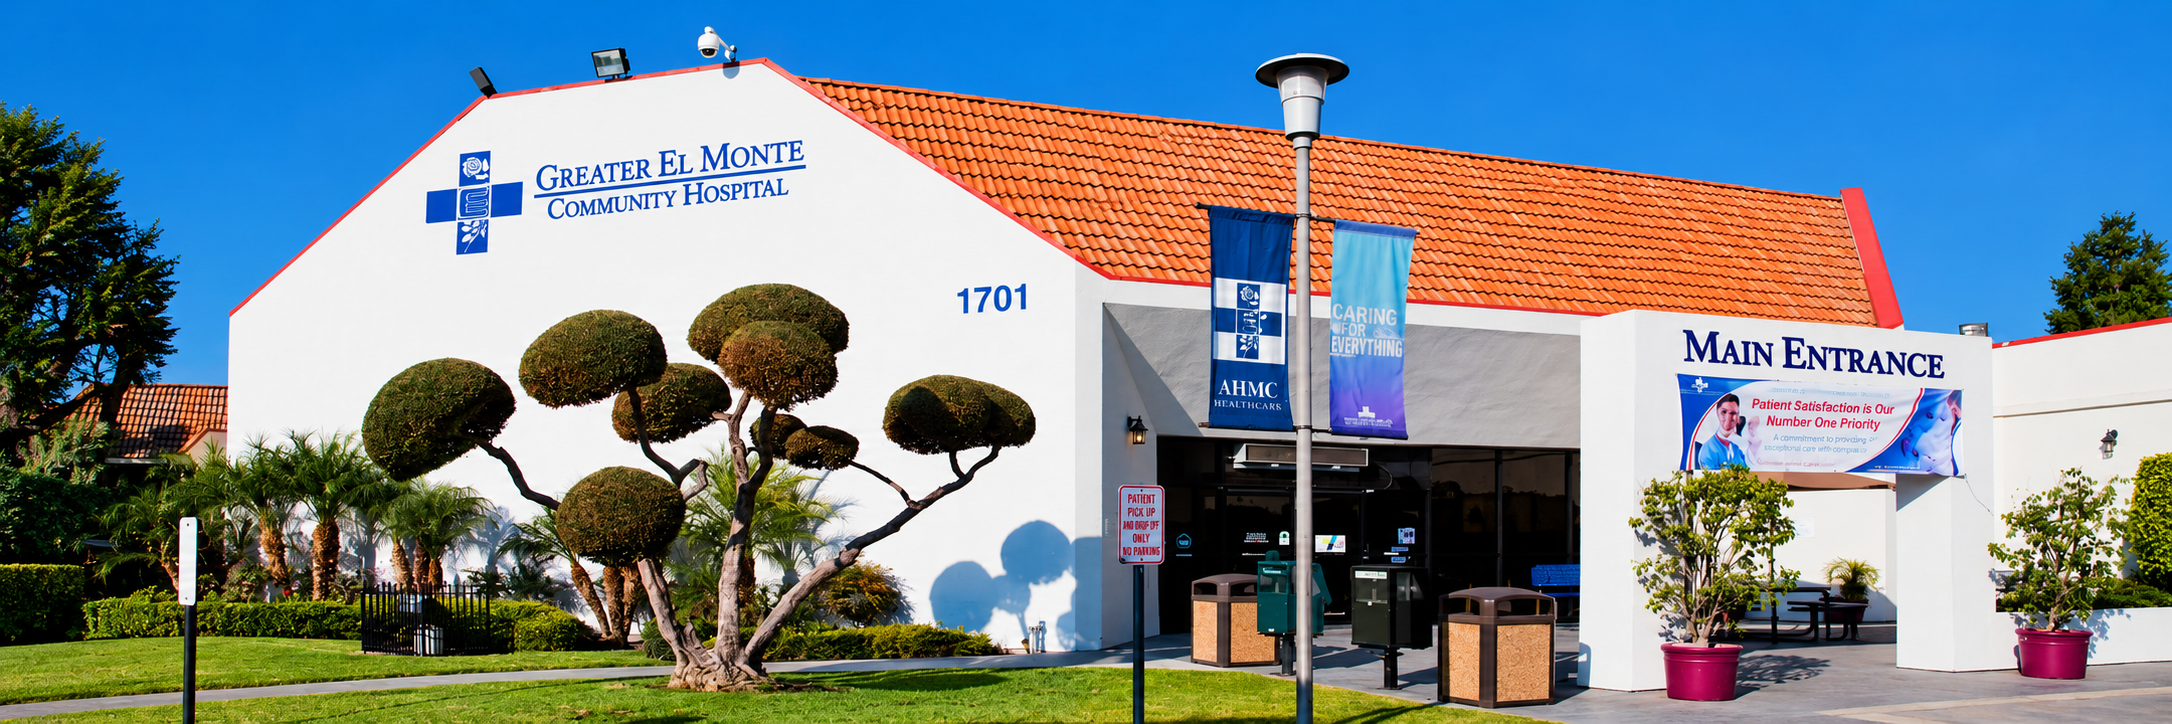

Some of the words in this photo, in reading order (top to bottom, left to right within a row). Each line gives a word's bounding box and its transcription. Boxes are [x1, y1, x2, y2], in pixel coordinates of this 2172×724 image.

[535, 158, 652, 192] GREATER
[657, 149, 694, 178] EL
[700, 139, 805, 173] MONTE
[546, 190, 678, 220] COMMUNITY
[682, 177, 790, 206] HOSPITAL
[956, 282, 1027, 314] 1701
[1332, 303, 1398, 326] CARING
[1341, 322, 1366, 337] FOR
[1331, 335, 1403, 358] EVERYTHING
[1682, 329, 1774, 367] MAIN
[1781, 336, 1946, 379] ENTRANCE
[1218, 379, 1279, 399] AHMC
[1751, 397, 1793, 411] Patient
[1793, 400, 1860, 414] Satisfaction
[1862, 402, 1872, 414] is
[1874, 403, 1895, 415] Our
[1766, 415, 1813, 428] Number
[1814, 416, 1838, 429] One
[1839, 417, 1881, 433] Priority
[1127, 493, 1156, 505] PATIENT
[1127, 506, 1144, 518] PICK
[1145, 507, 1156, 518] UP
[1132, 532, 1150, 544] ONLY
